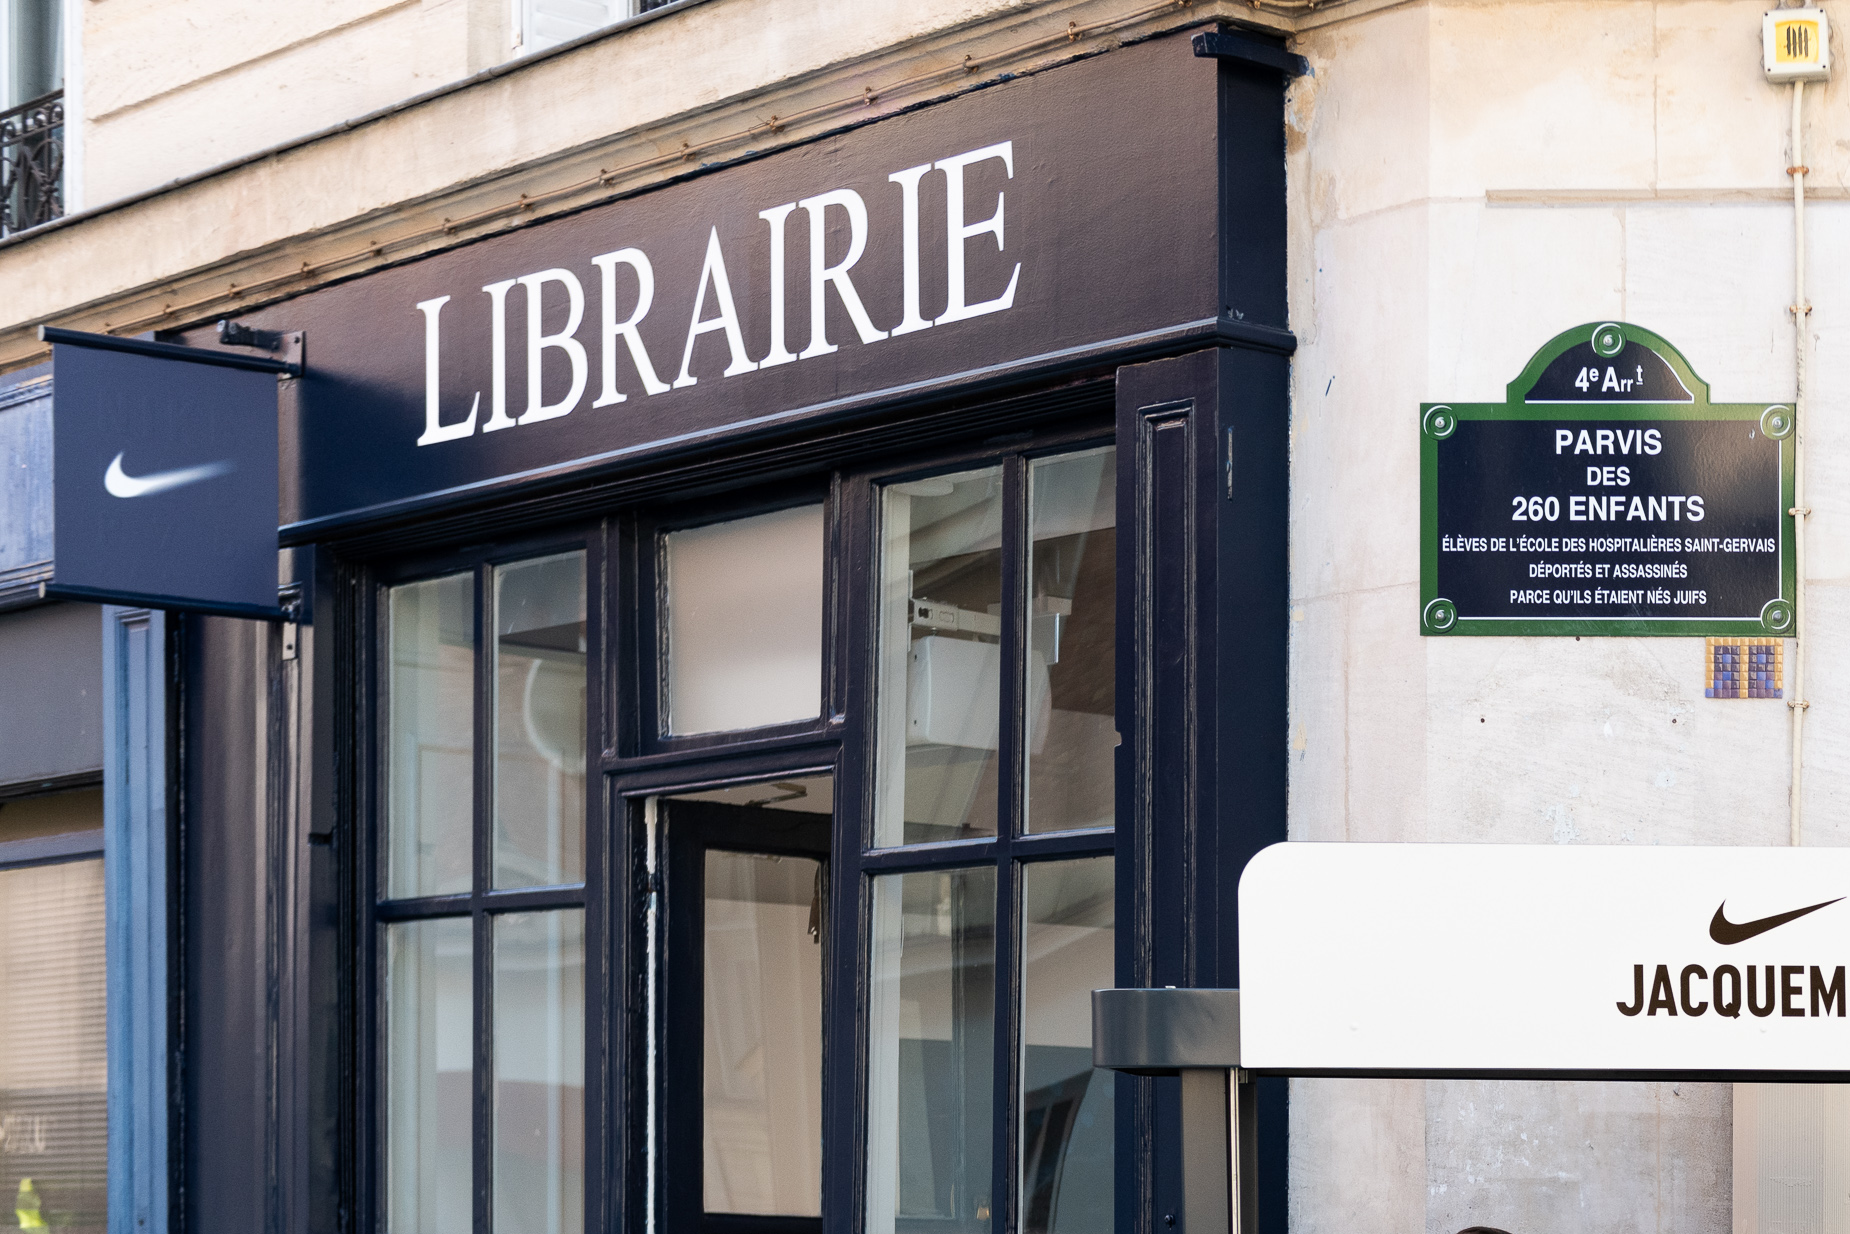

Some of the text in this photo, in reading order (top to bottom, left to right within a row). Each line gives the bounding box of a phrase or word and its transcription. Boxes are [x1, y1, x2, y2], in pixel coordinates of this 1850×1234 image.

[417, 141, 1021, 446] LIBRAIRIE
[1555, 428, 1662, 455] PARVIS
[1586, 466, 1631, 487] DES
[1511, 495, 1705, 522] 260 ENFANTS
[1442, 534, 1775, 552] ÉLÈVES DE L'ÉCOLE DES HOSPITALIÈRES SAINT-GERVAIS
[1529, 560, 1688, 578] DÉPORTÉS ET ASSASSINÉS
[1510, 586, 1707, 605] PARCE QU'ILS ÉTAIENT NÉS JUIFS
